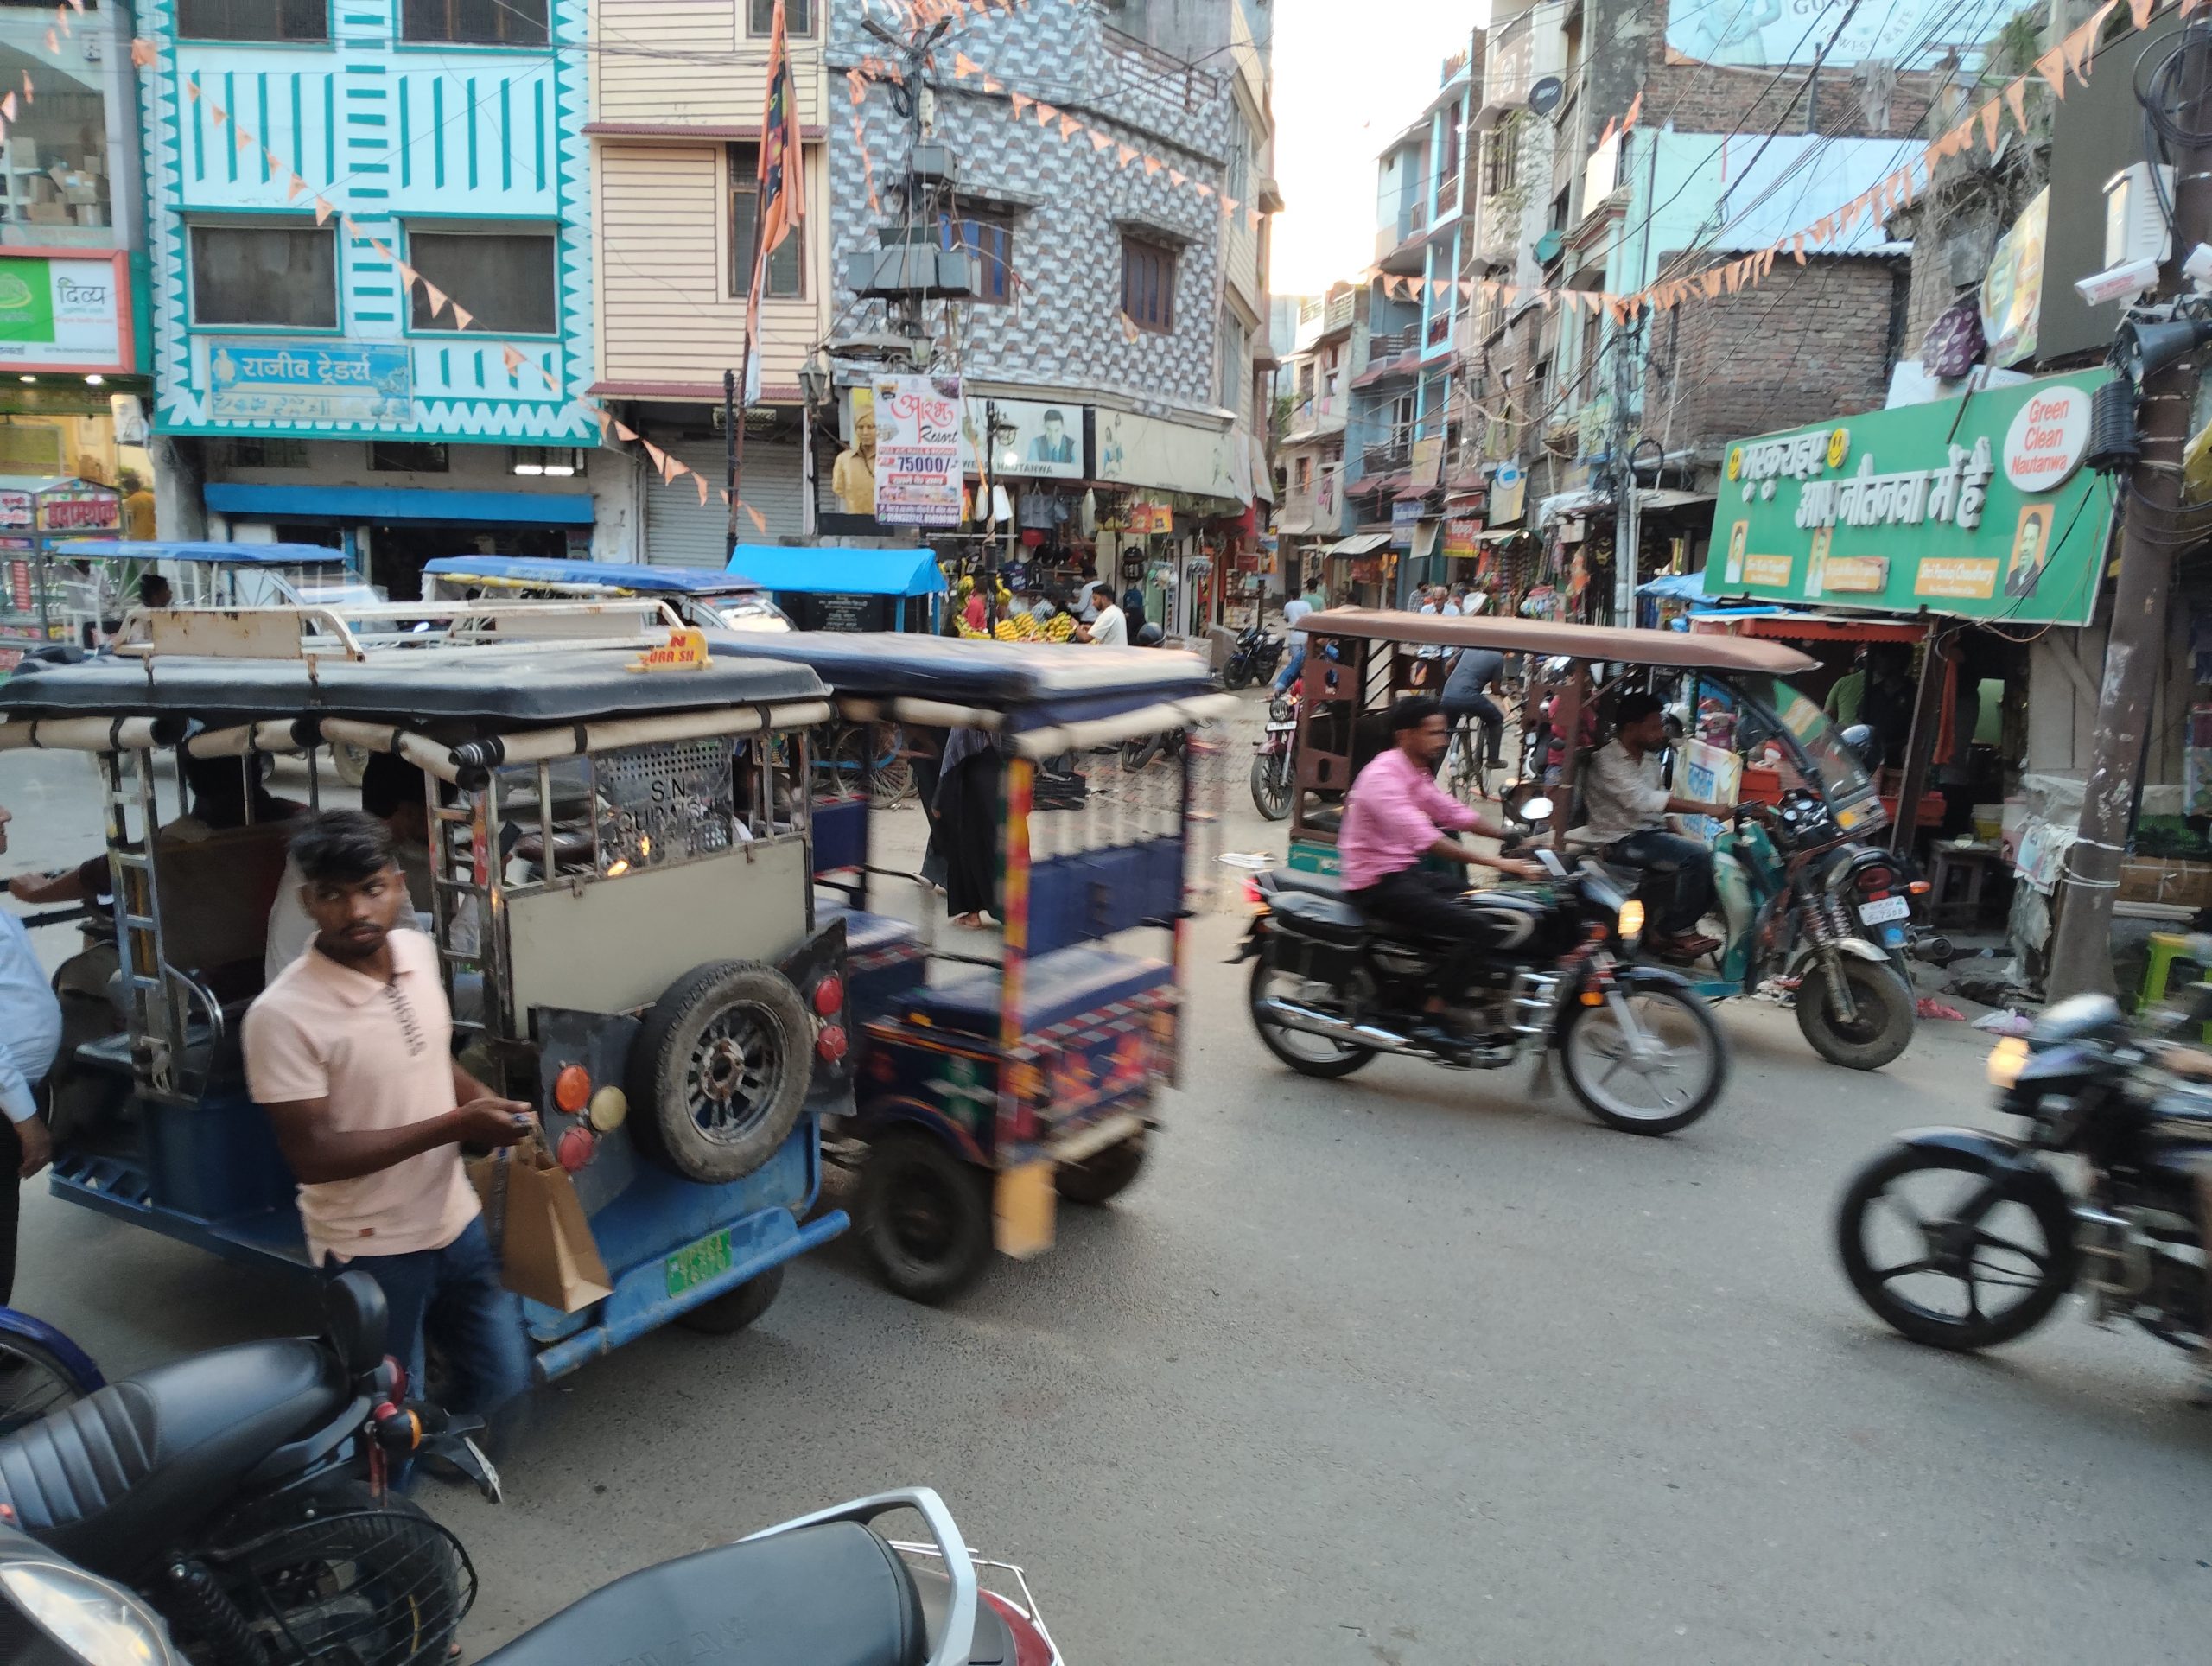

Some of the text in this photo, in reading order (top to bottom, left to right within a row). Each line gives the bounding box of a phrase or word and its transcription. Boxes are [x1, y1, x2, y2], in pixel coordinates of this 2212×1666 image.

[1882, 9, 1913, 45] RATE
[57, 277, 106, 305] दिव्य
[242, 352, 372, 385] राजीव ट्रेडर्स
[2029, 398, 2069, 423] Green
[919, 425, 958, 443] Resort
[2024, 426, 2063, 451] Clean
[1740, 429, 1830, 503] मुस्कुराइए
[2011, 455, 2068, 475] Nautanwa
[1795, 480, 1839, 529] आप
[1838, 453, 1929, 525] नौतनवा
